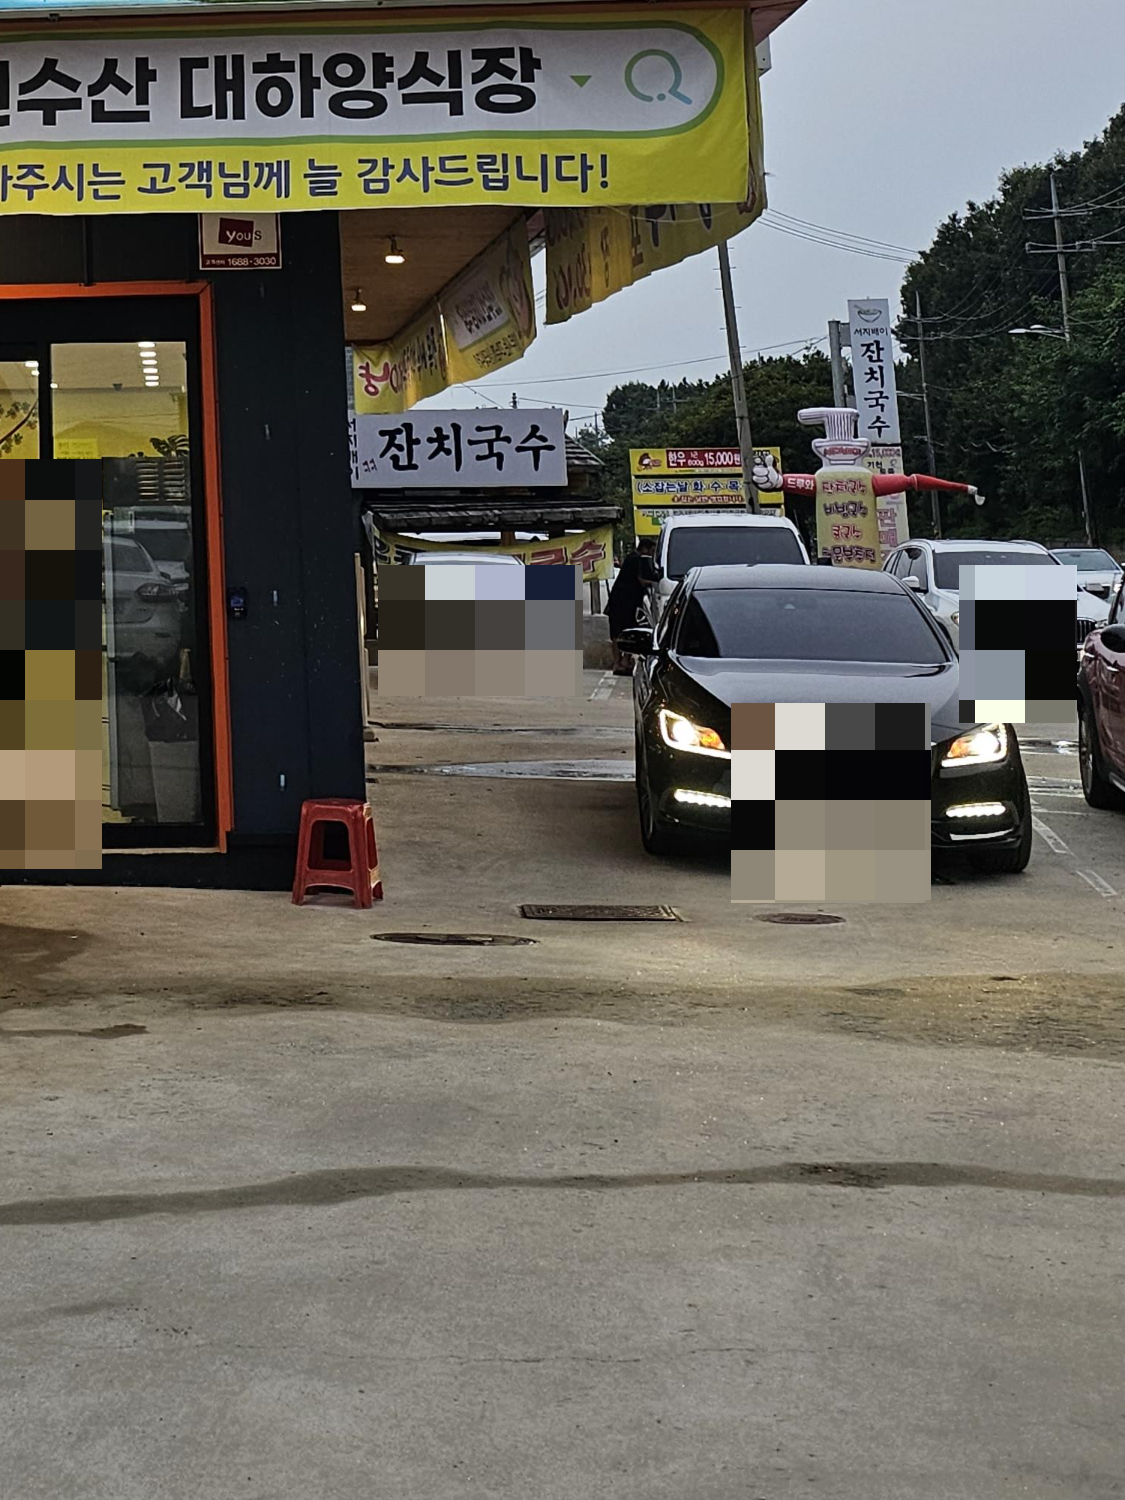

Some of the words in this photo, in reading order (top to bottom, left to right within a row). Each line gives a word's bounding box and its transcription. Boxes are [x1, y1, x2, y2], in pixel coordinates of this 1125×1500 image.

[179, 47, 541, 120] 대하양식장
[136, 159, 291, 200] 고객님께
[302, 158, 342, 197] 늘
[357, 152, 610, 194] 감사드립니다!
[860, 340, 891, 438] 잔치국수
[378, 422, 556, 472] 잔치국수
[668, 451, 686, 467] 한우
[787, 477, 814, 491] 드루와
